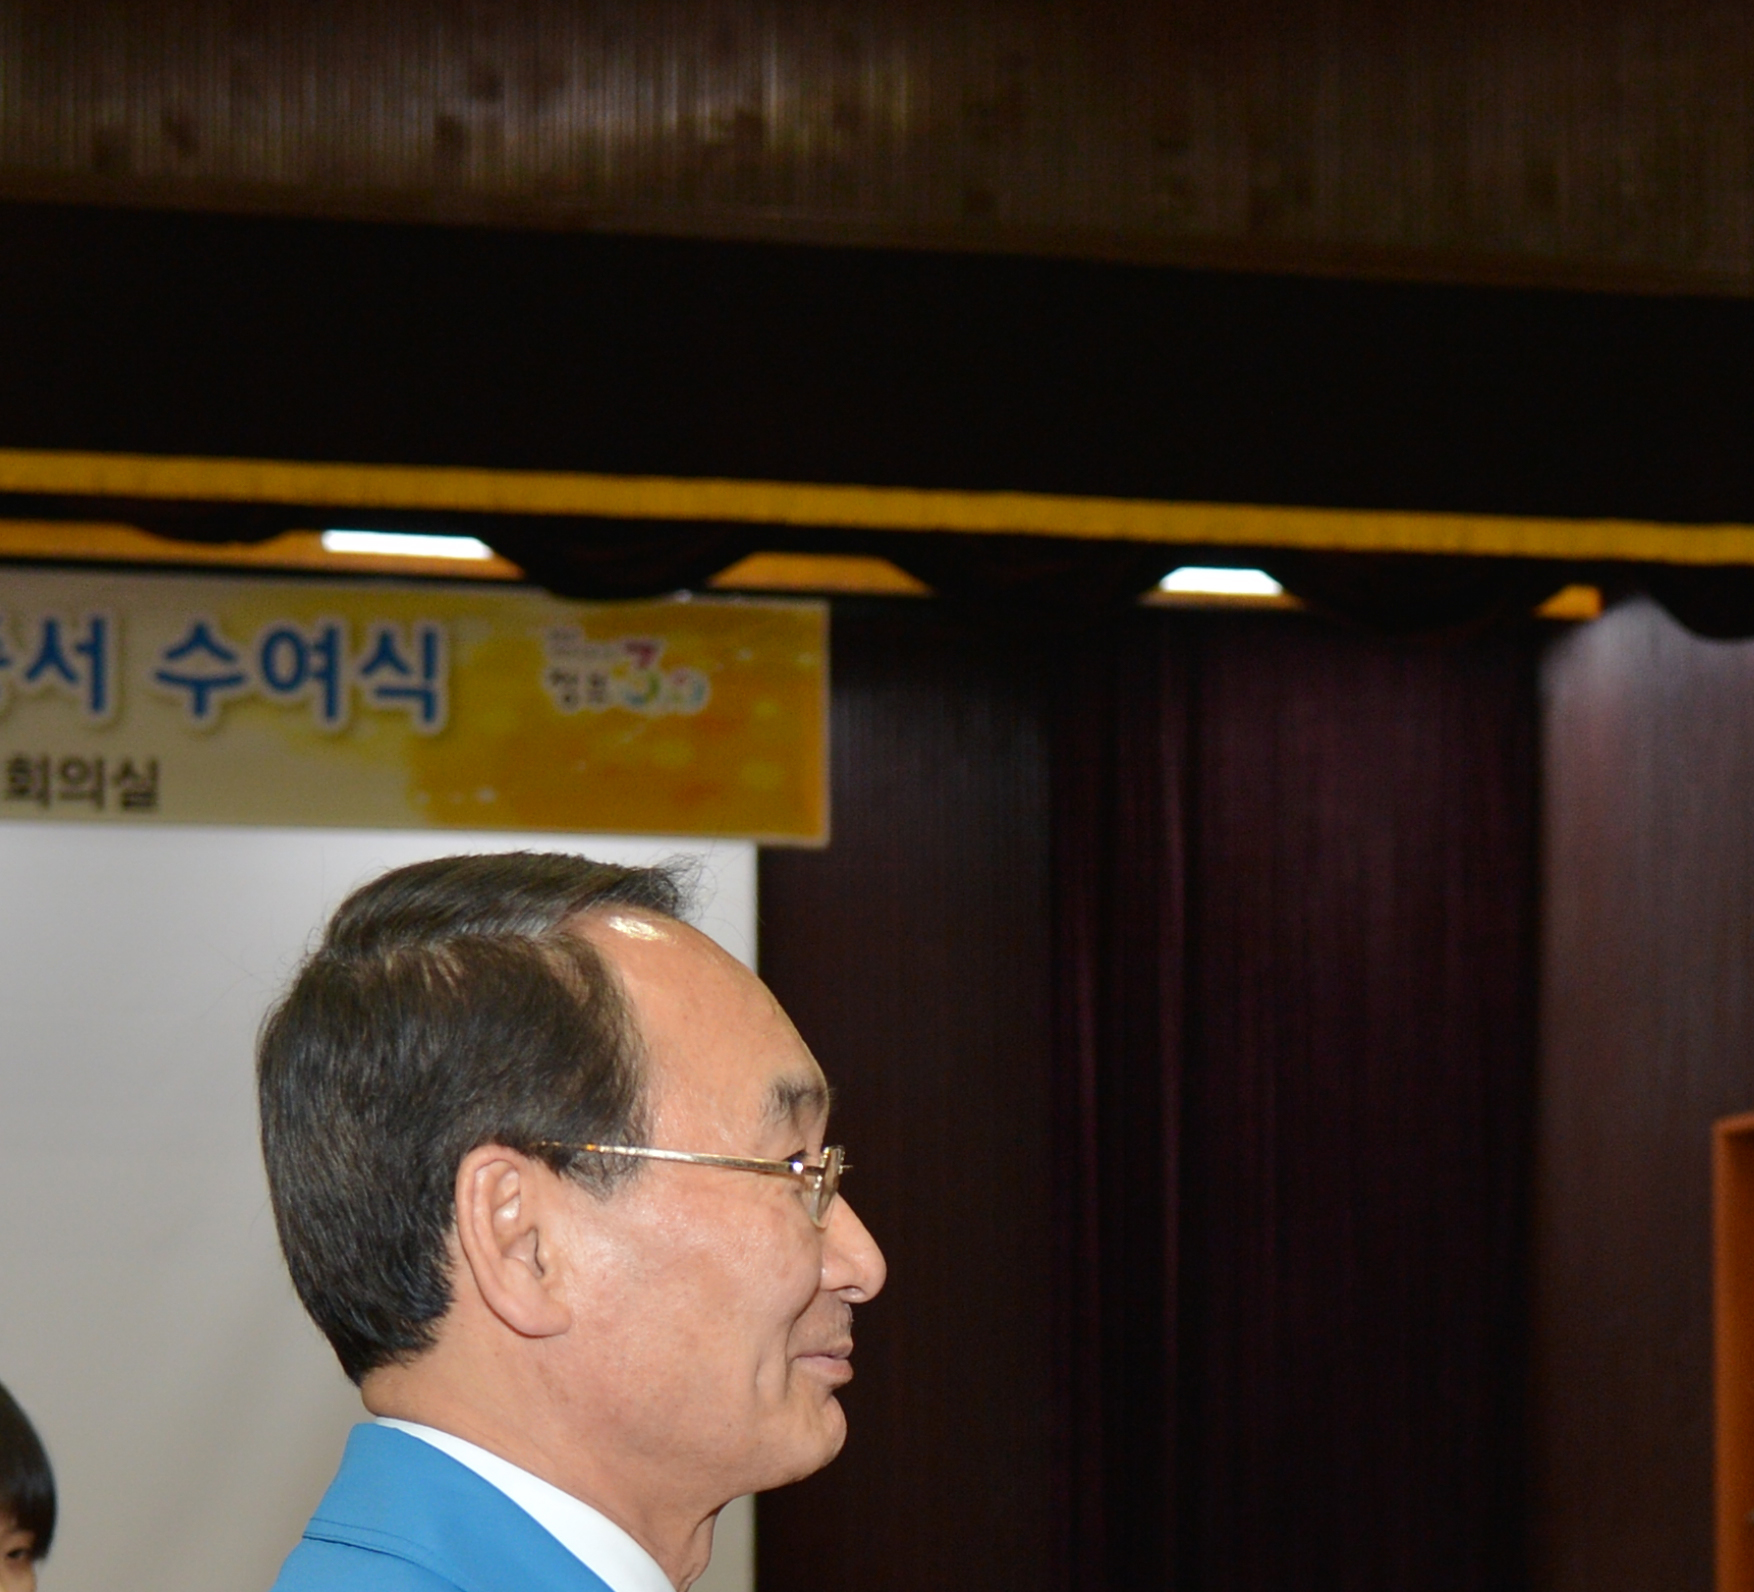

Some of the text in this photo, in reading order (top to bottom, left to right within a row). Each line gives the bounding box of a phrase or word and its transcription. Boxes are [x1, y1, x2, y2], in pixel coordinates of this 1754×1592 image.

[0, 616, 440, 725] 서 수여식
[5, 754, 160, 811] 회의실
